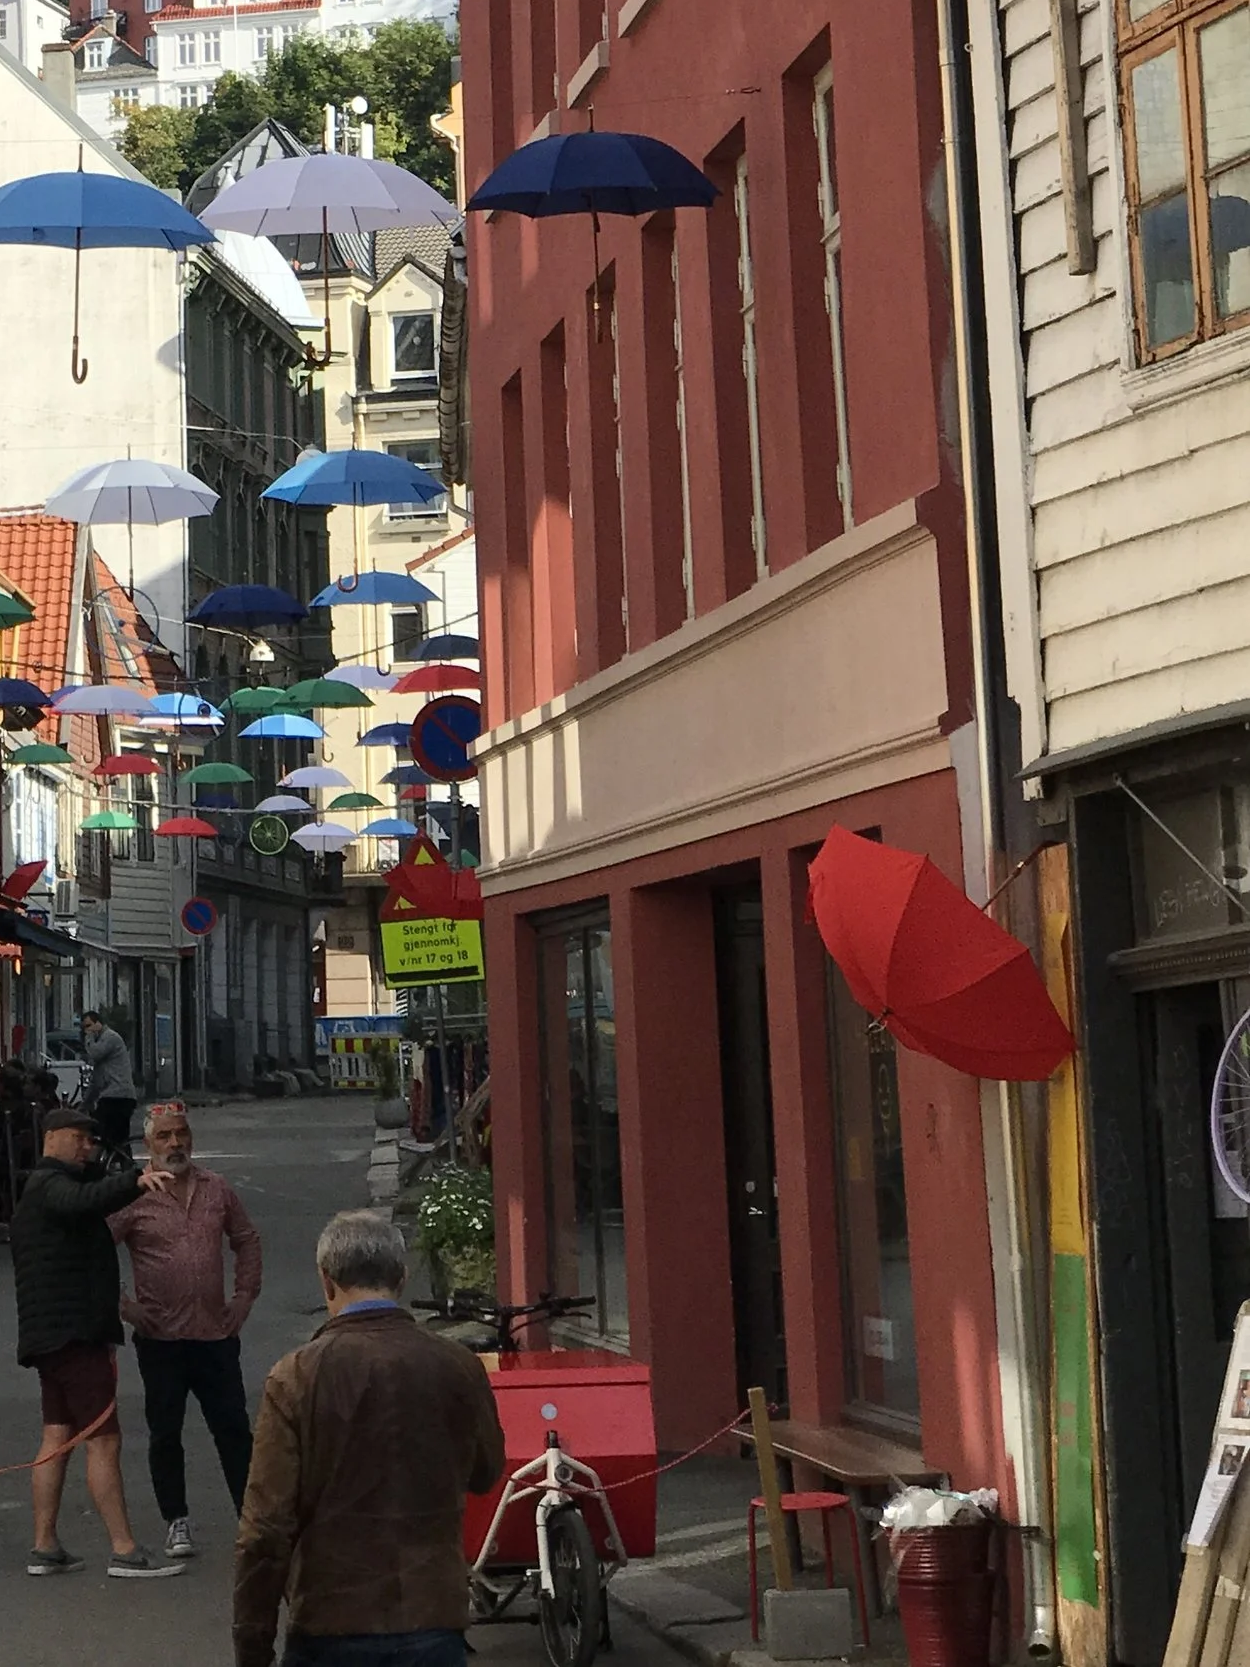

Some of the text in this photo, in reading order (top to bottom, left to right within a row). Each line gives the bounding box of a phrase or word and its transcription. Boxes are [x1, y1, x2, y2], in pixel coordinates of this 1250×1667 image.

[403, 924, 438, 935] Stengt
[403, 935, 462, 951] gjennomkj.
[426, 953, 436, 963] 17
[440, 954, 454, 964] og
[457, 950, 469, 960] 18
